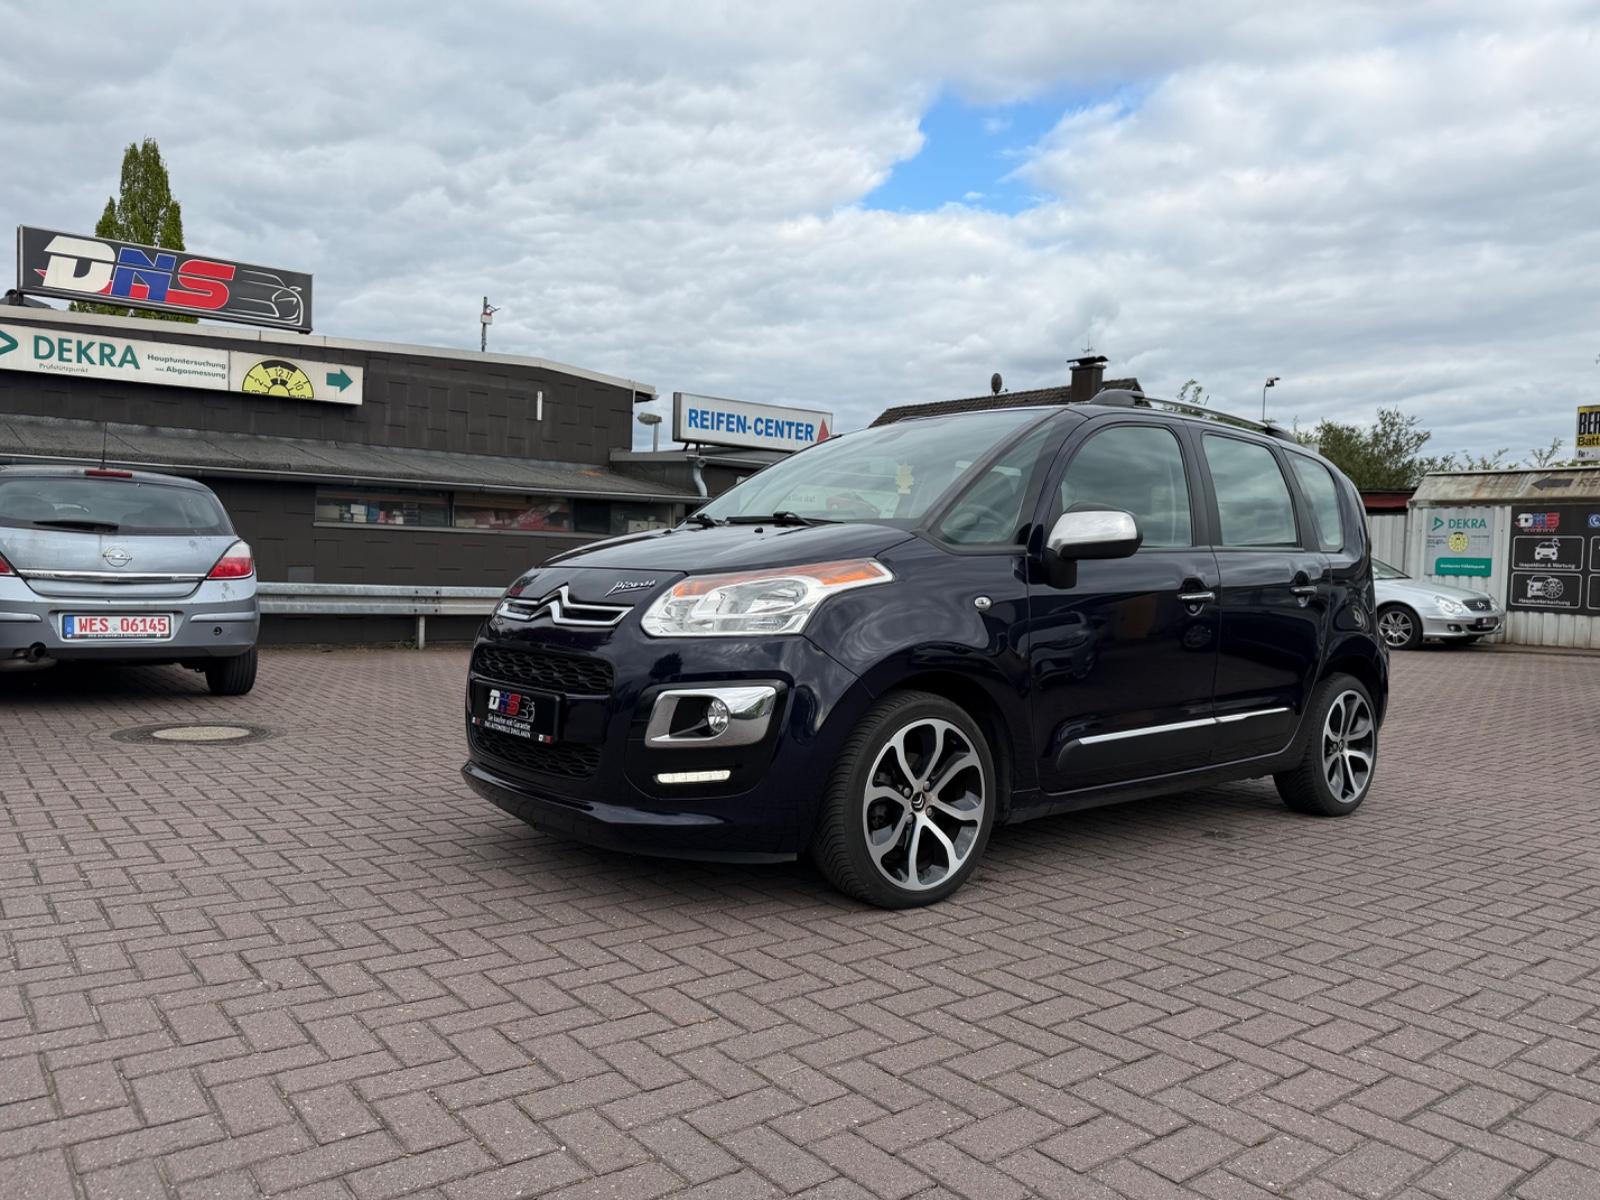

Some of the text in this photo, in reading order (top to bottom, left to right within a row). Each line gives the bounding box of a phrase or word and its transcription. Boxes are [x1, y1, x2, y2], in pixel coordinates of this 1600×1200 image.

[42, 235, 236, 309] DNS
[33, 335, 141, 370] DEKRA
[147, 353, 226, 370] Hauptuntersuchung
[166, 365, 226, 380] Abgasmessung
[688, 408, 815, 441] REIFEN-CENTER
[1448, 518, 1487, 529] DEKRA
[1517, 512, 1560, 528] DNS
[78, 618, 167, 632] WES 06145
[488, 689, 521, 715] DNS
